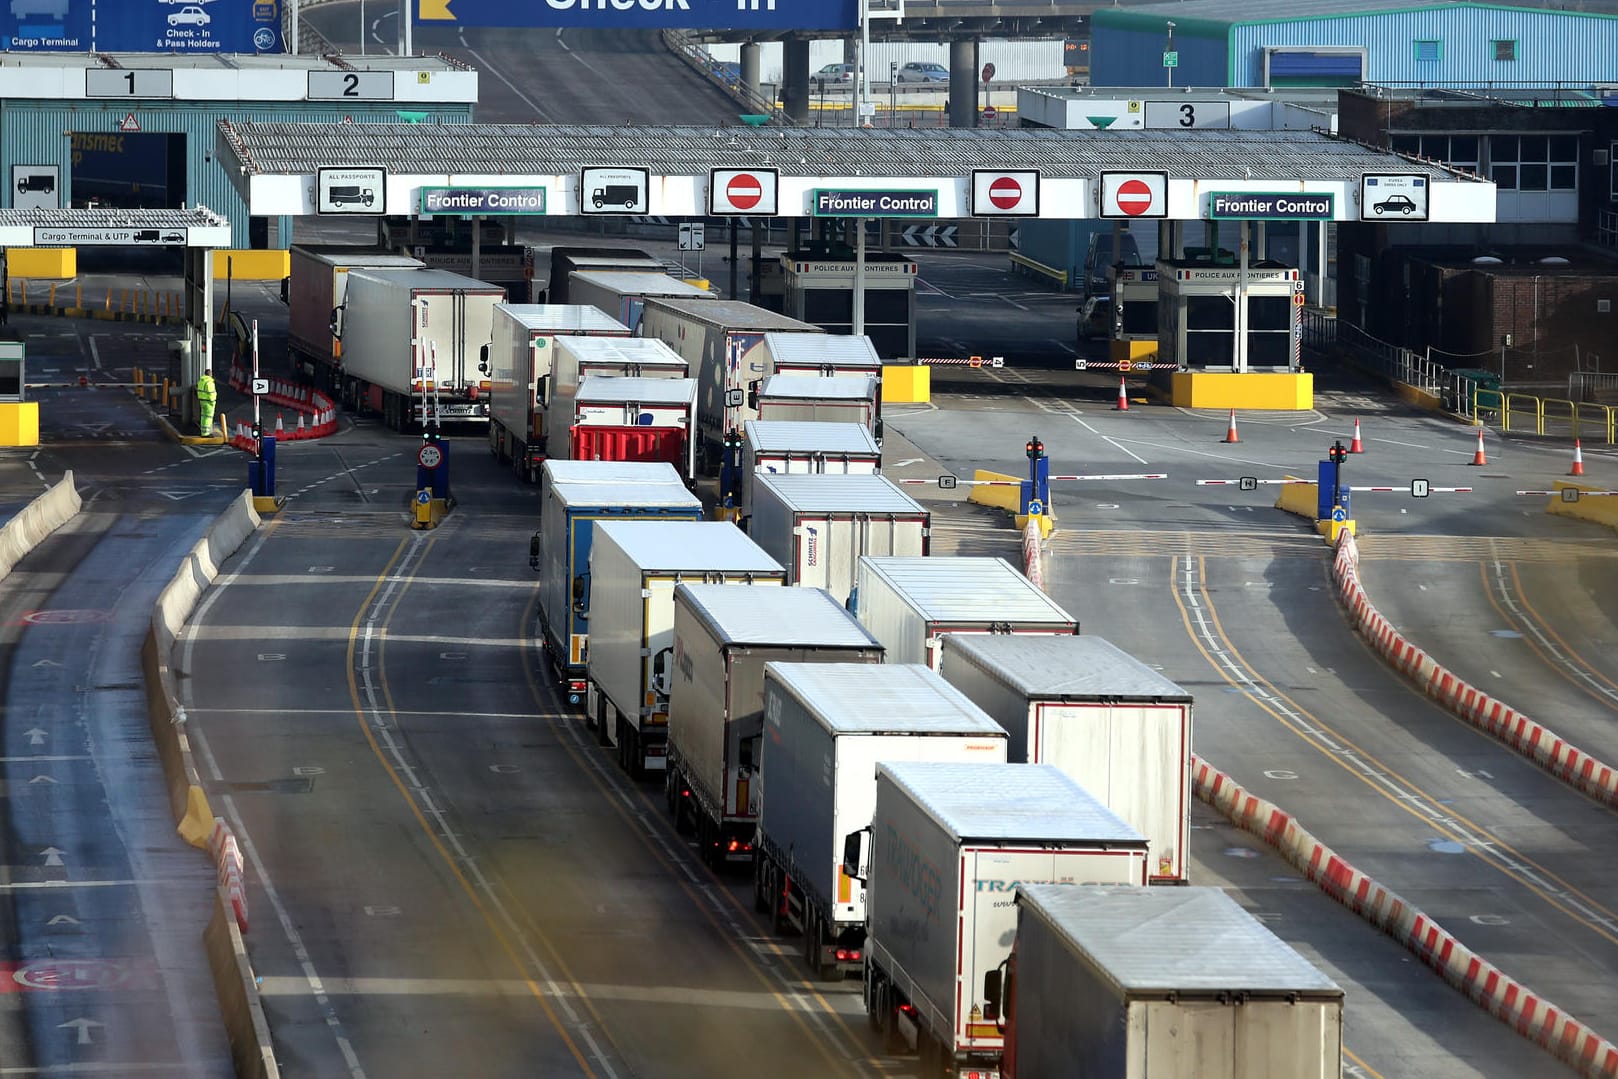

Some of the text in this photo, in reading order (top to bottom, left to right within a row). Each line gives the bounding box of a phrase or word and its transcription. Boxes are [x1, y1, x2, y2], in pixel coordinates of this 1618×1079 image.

[166, 29, 194, 38] Check
[202, 29, 211, 38] In
[11, 37, 79, 48] Cargo Terminal
[156, 39, 221, 48] & Pass Holders
[125, 71, 136, 95] 1
[343, 73, 360, 97] 2
[1179, 104, 1196, 127] 3
[427, 194, 542, 208] Frontier Control
[819, 195, 933, 210] Frontier Control
[1215, 199, 1330, 214] Frontier Control
[41, 231, 130, 242] Cargo Terminal & UTP
[1146, 272, 1159, 280] UK
[1296, 281, 1302, 290] 6
[256, 382, 265, 391] A
